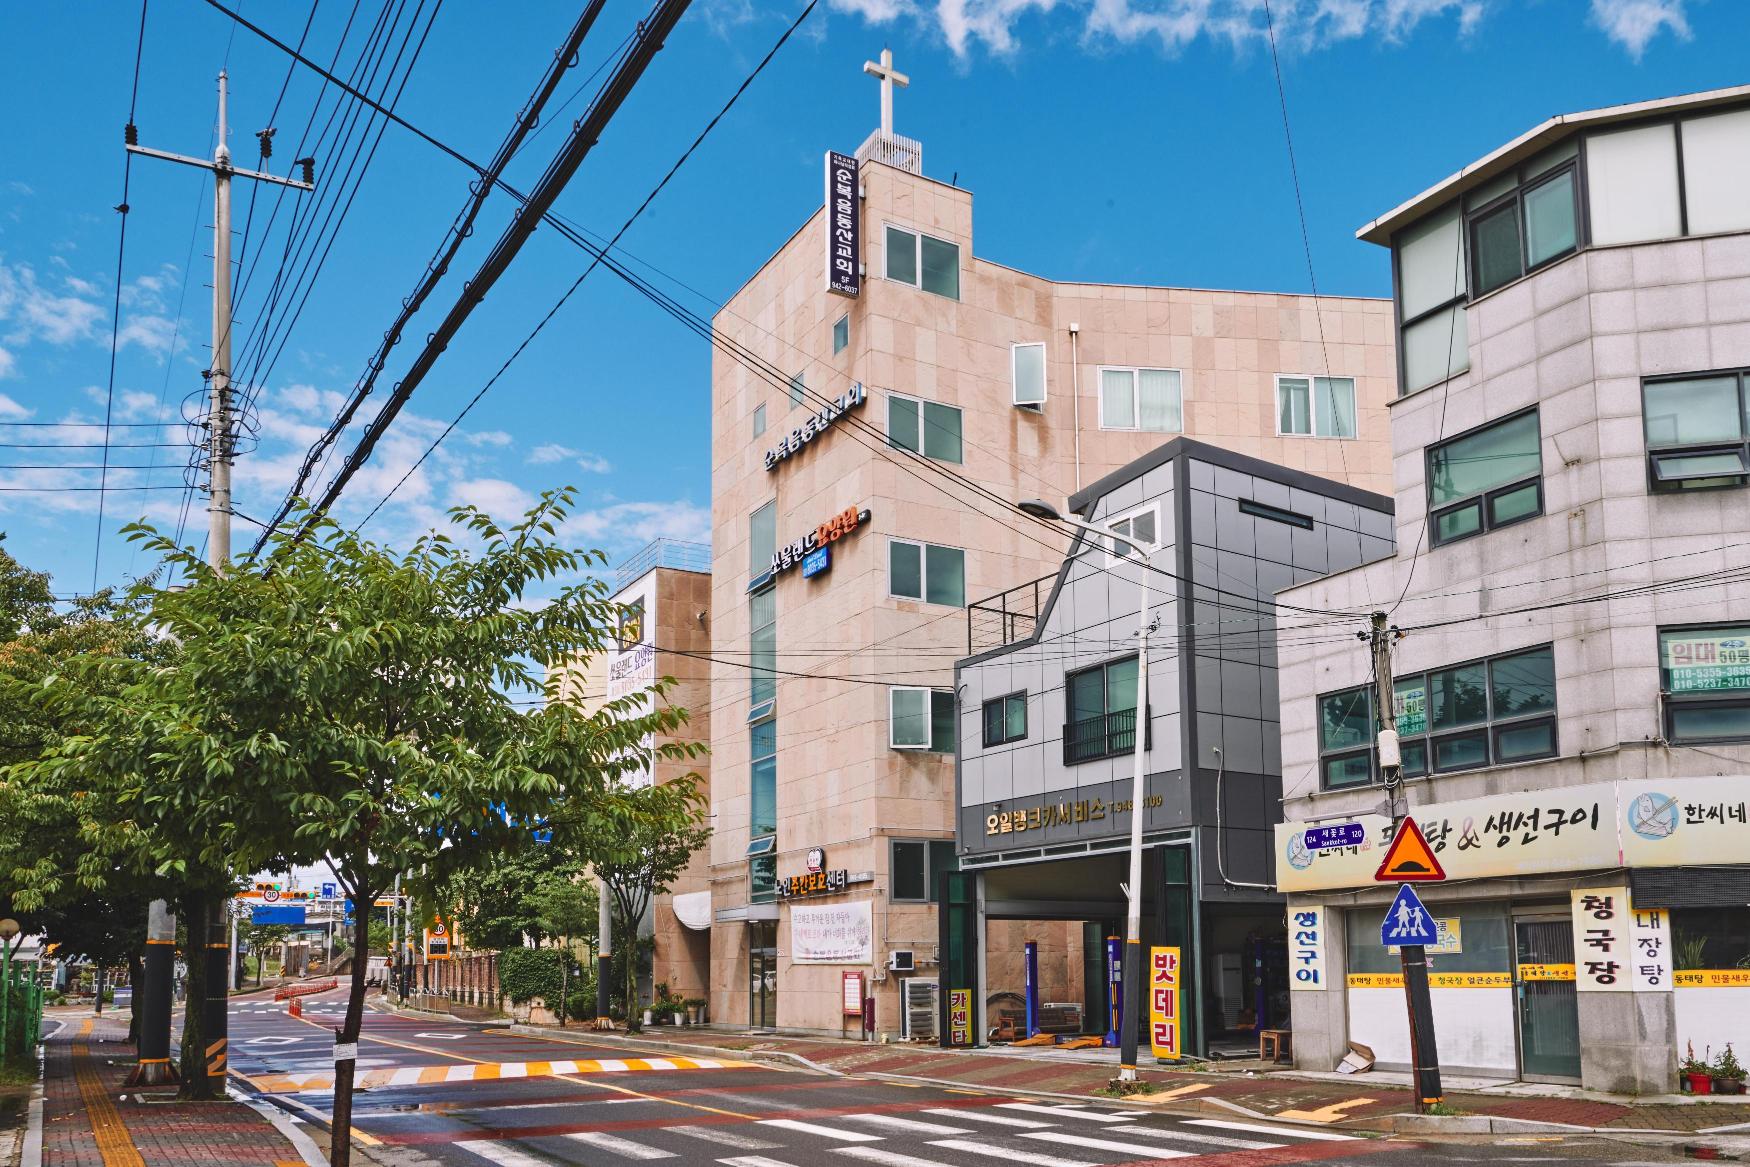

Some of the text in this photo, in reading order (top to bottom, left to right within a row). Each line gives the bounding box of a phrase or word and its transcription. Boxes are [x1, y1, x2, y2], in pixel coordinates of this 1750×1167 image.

[836, 169, 853, 275] 순복음동산교회
[831, 281, 858, 294] 942-6037
[1672, 643, 1716, 665] 임대
[1352, 830, 1362, 838] 120
[1457, 817, 1481, 850] &
[1484, 803, 1599, 848] 생선구이
[1685, 802, 1747, 824] 한씨네
[1294, 912, 1319, 984] 생선구이
[1581, 895, 1620, 985] 청국장
[1636, 912, 1664, 985] 내장탕
[1350, 977, 1371, 985] 동태탕
[1438, 977, 1462, 985] 청국장
[1675, 974, 1704, 984] 동태탕
[952, 992, 966, 1042] 카센타
[1155, 955, 1176, 1052] 밧데리
